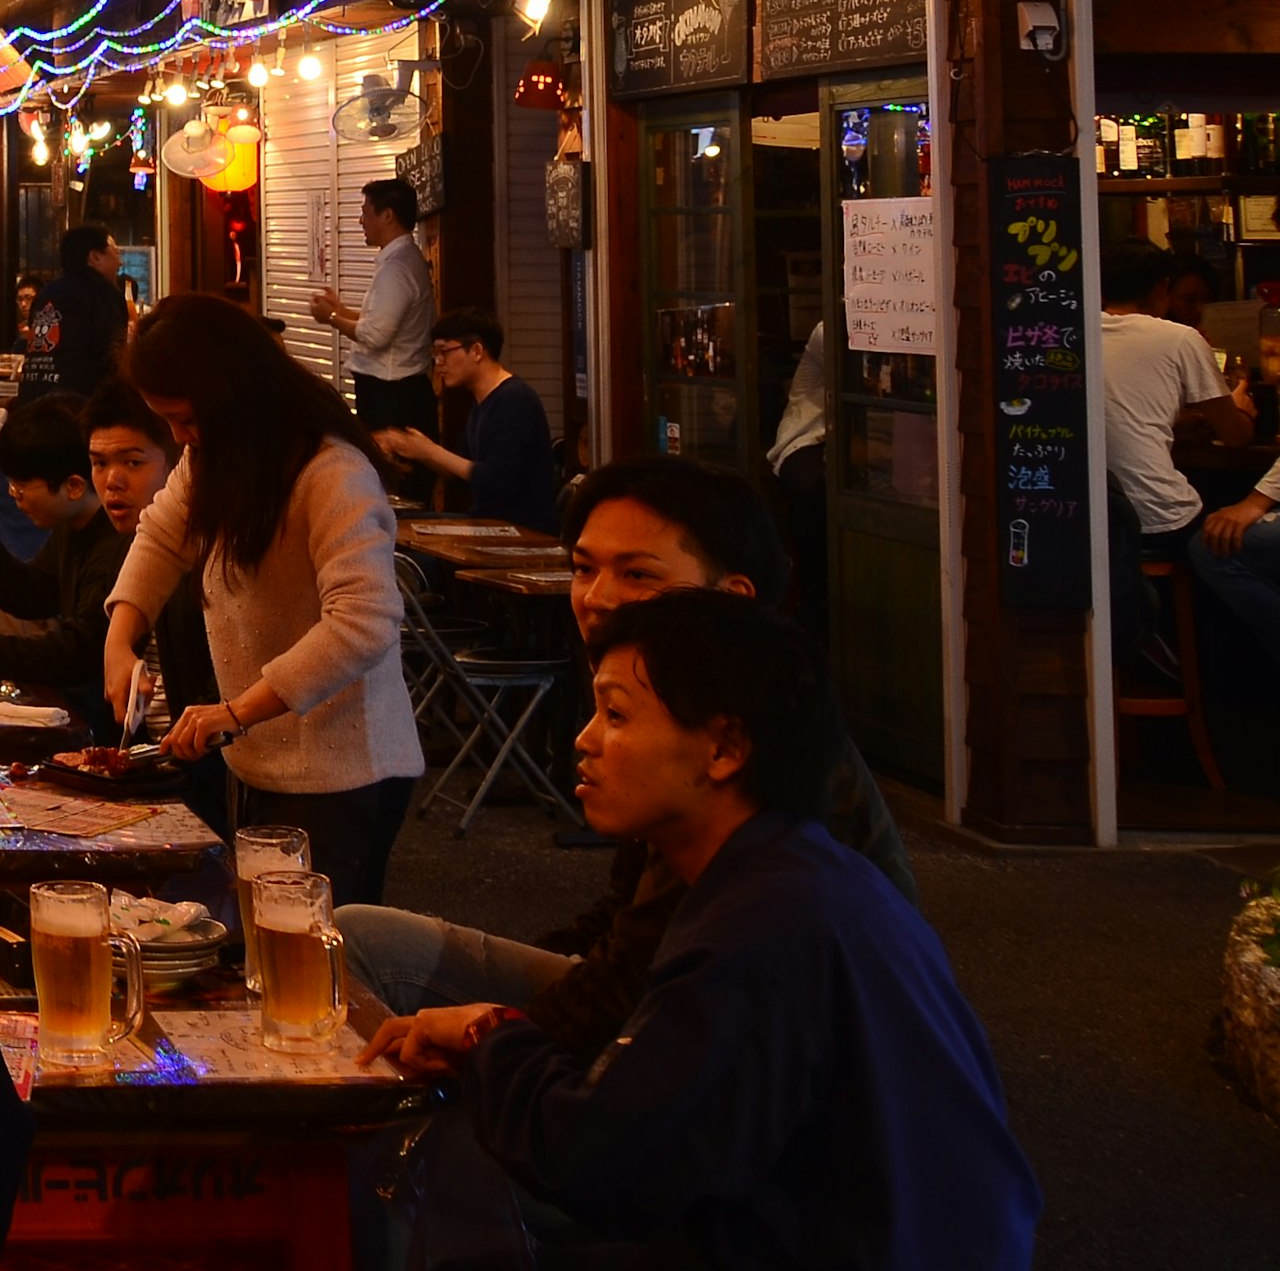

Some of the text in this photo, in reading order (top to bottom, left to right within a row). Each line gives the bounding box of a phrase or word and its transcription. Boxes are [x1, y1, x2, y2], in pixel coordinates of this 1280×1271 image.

[1007, 216, 1057, 244] プリ
[1027, 242, 1078, 272] プリ
[1003, 263, 1056, 285] エビの
[1025, 287, 1078, 310] アヒージョ
[1003, 351, 1045, 371] 焼いた
[1018, 373, 1084, 391] タコライス
[1013, 442, 1066, 461] たっぷり
[1008, 464, 1055, 490] 泡盛
[1015, 496, 1078, 518] サングリア
